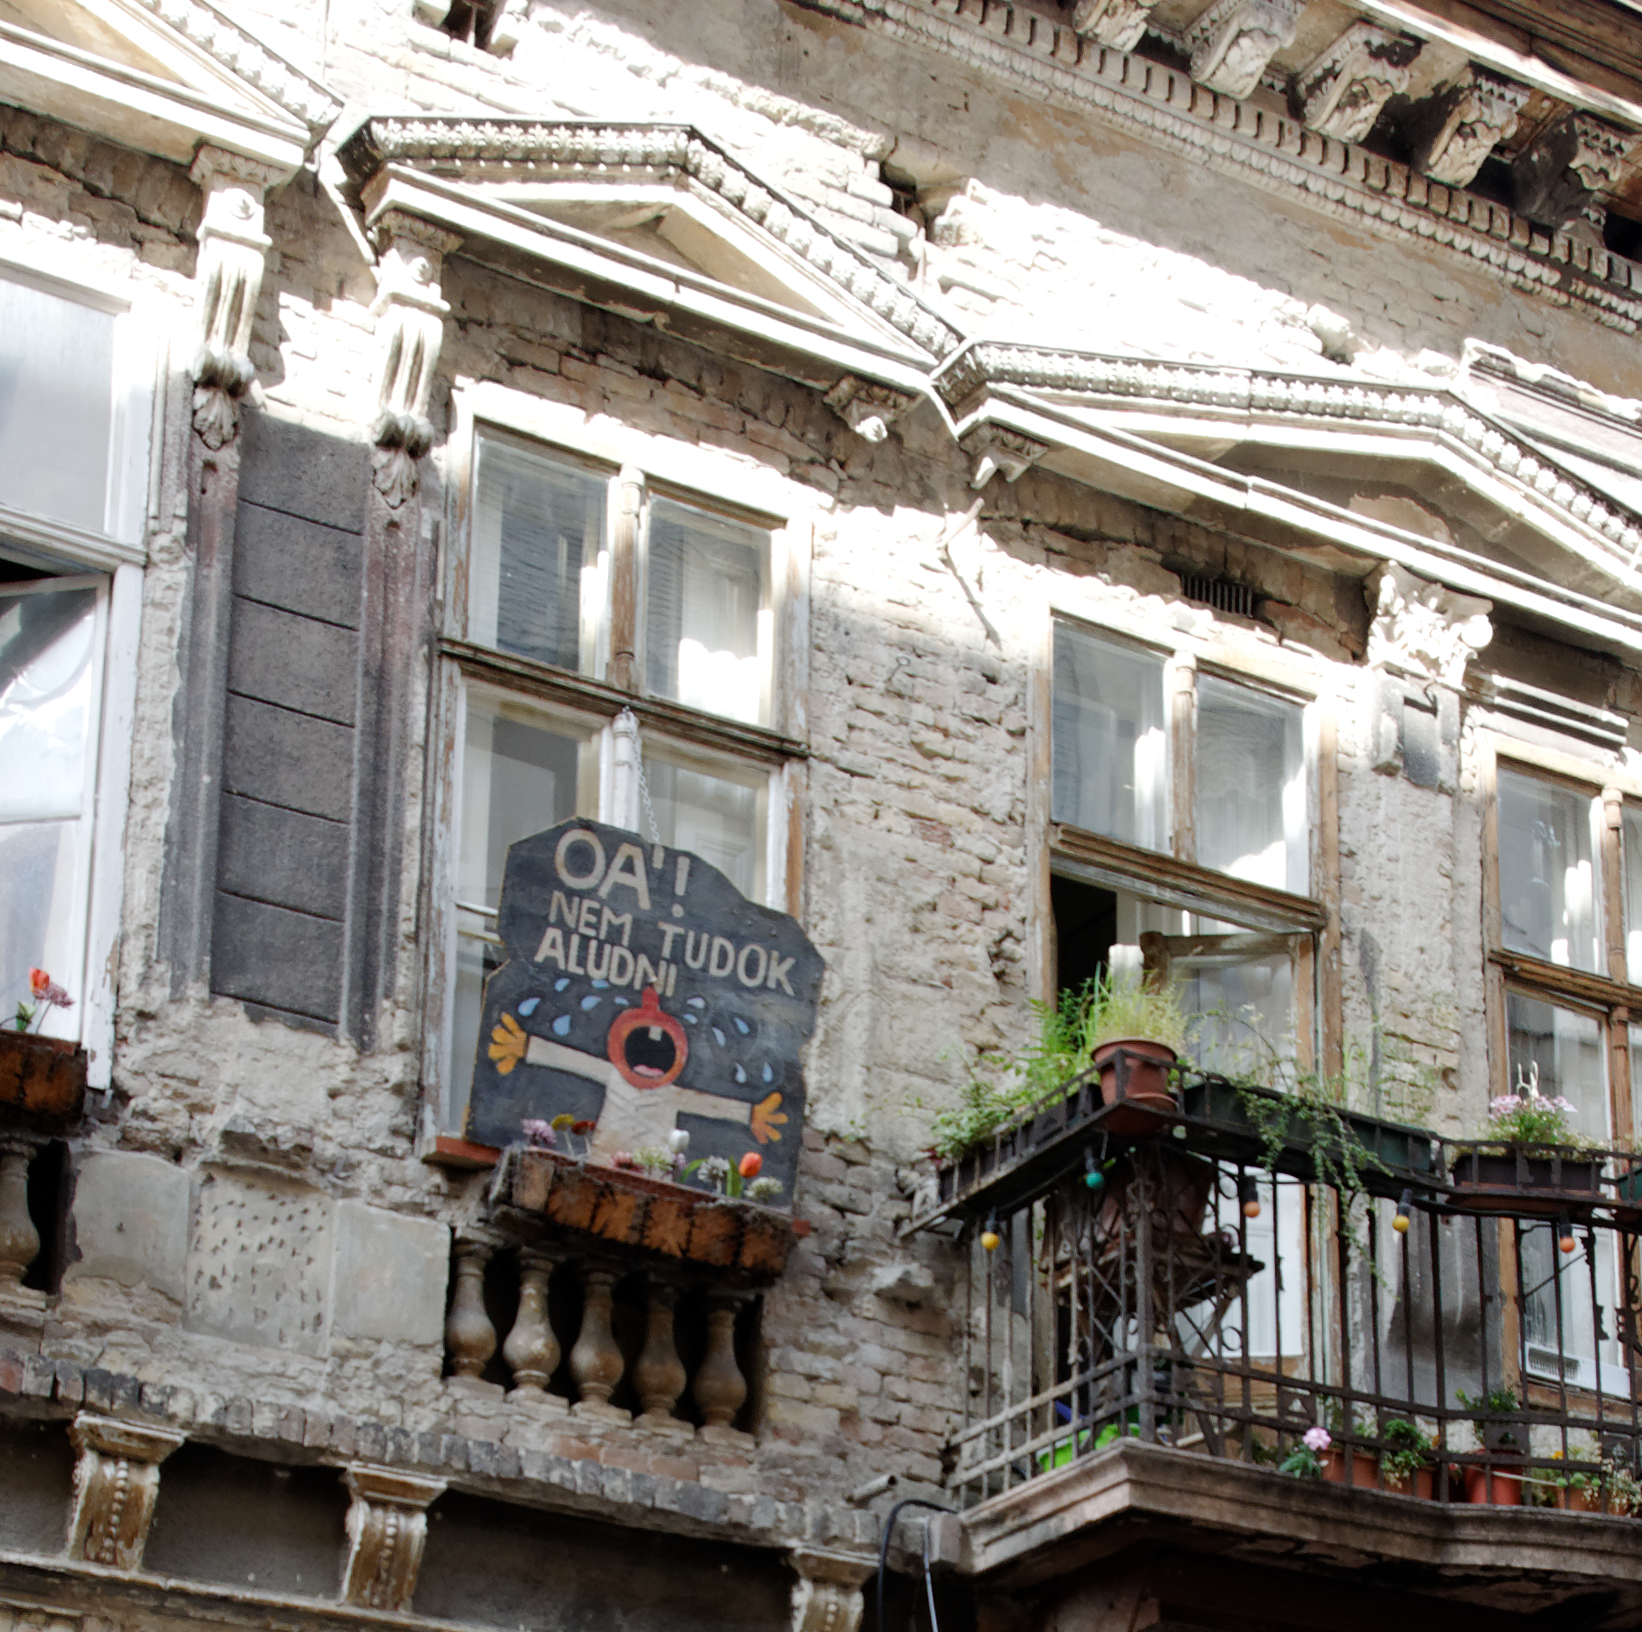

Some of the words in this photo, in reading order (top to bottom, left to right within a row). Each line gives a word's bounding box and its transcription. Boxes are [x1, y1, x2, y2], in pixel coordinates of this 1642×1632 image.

[534, 928, 677, 997] ALUDNI
[549, 890, 632, 946] NEM
[658, 921, 795, 995] TUDOK
